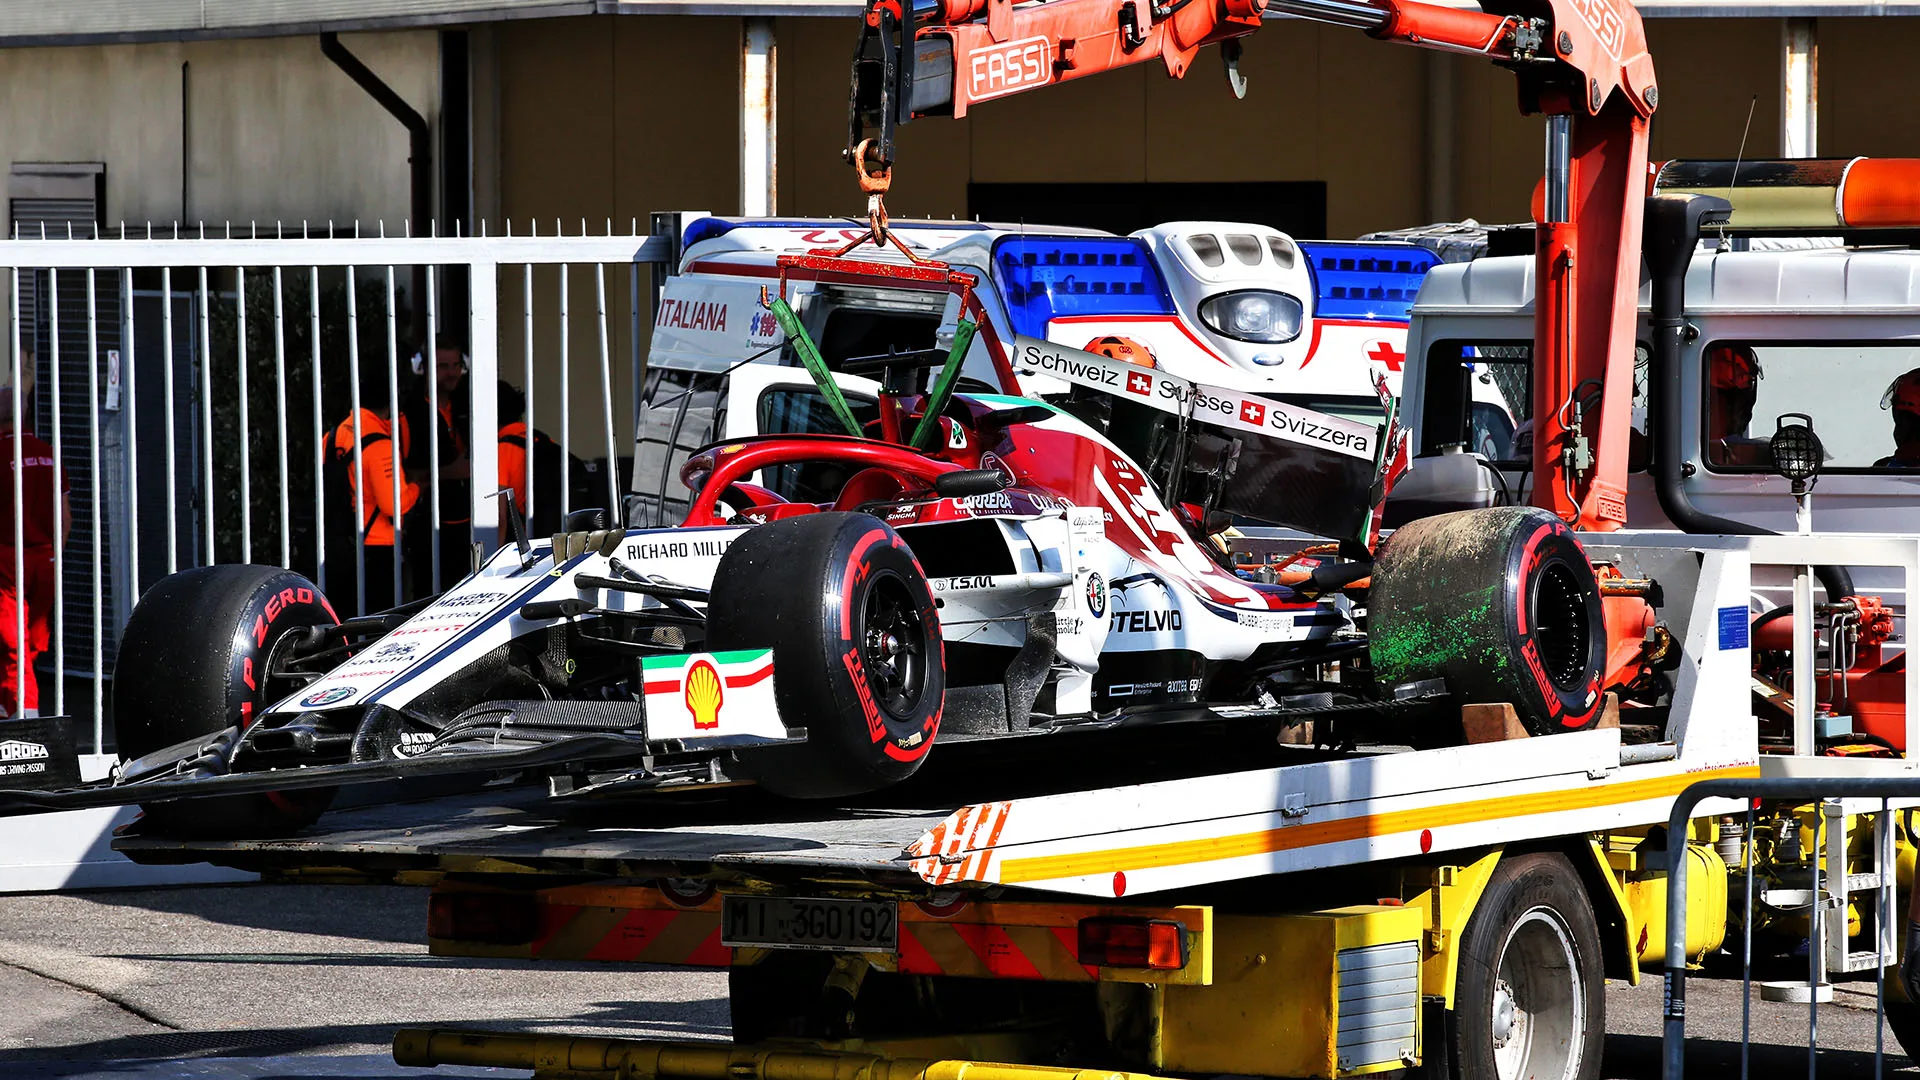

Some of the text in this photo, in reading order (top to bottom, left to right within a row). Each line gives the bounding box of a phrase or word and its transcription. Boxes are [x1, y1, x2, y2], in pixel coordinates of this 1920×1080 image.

[972, 43, 1045, 92] FASSI
[657, 299, 727, 332] ITALIANA
[1024, 346, 1368, 452] Schweiz Susse Svizzera
[887, 512, 916, 521] SINGHA
[627, 542, 688, 560] RICHARD
[252, 587, 314, 649] ZERO
[0, 743, 49, 759] OROPA
[731, 902, 766, 937] MI
